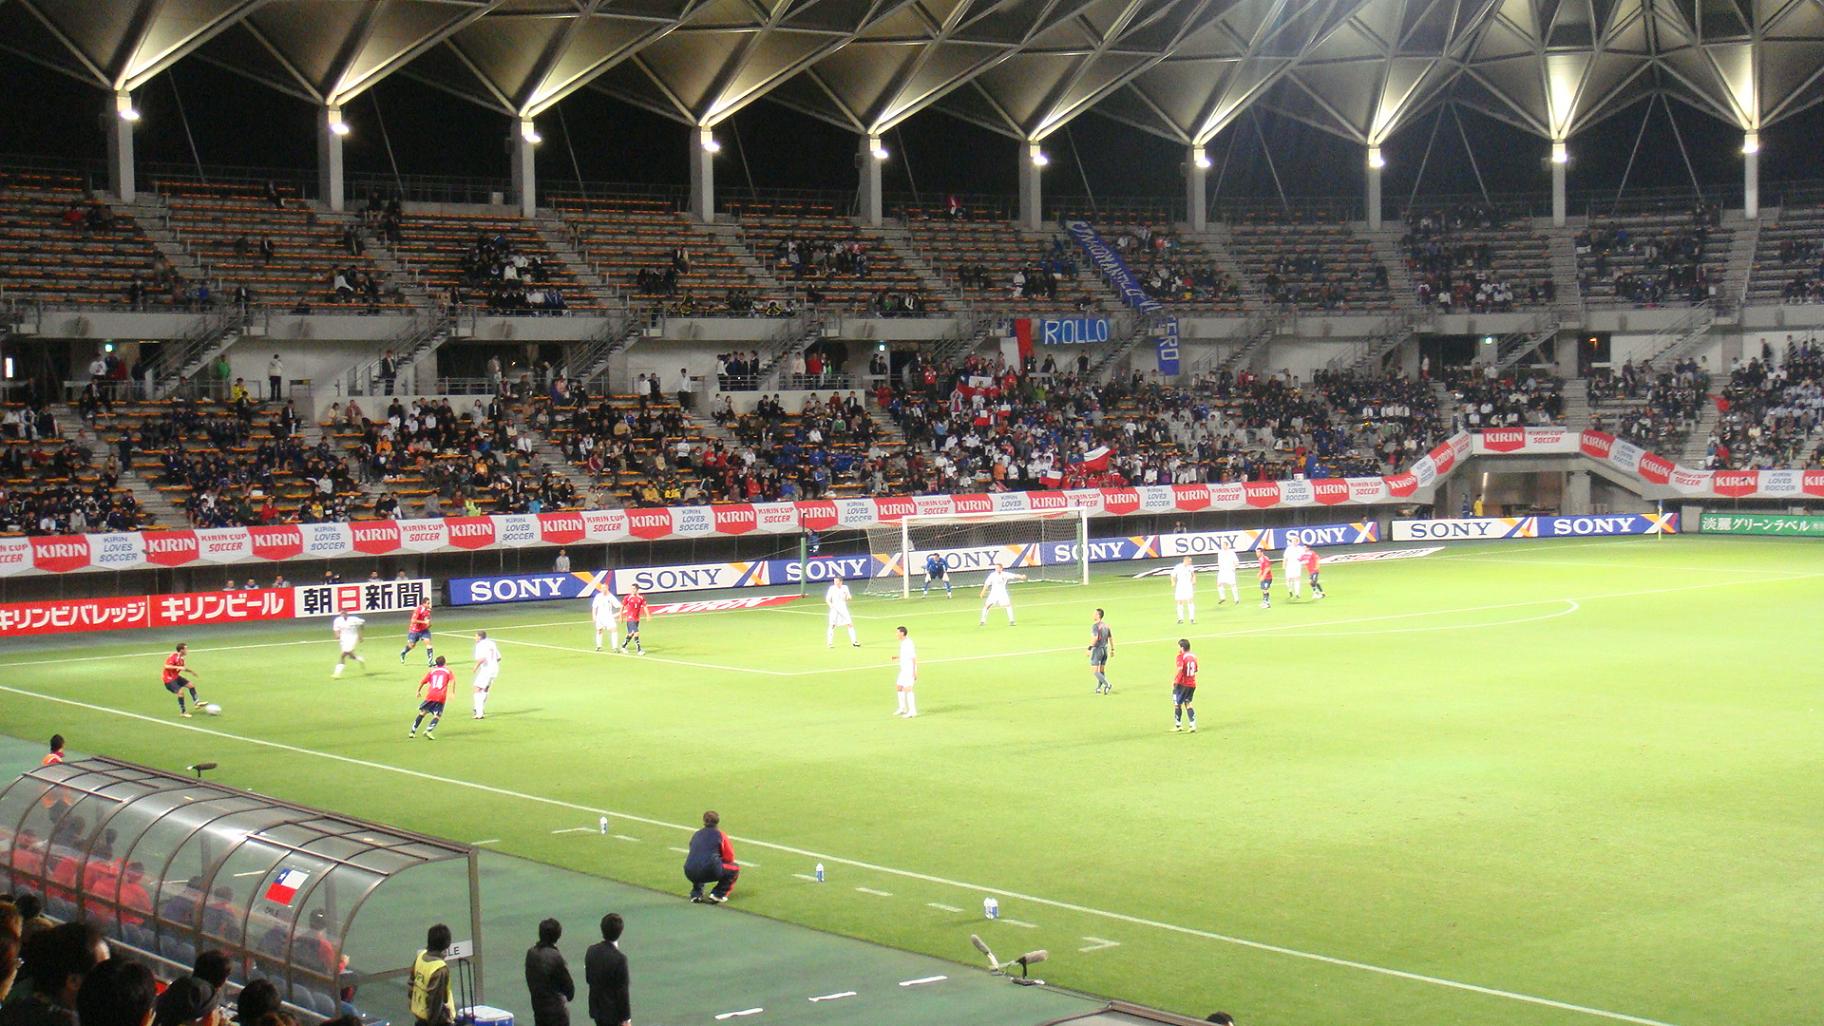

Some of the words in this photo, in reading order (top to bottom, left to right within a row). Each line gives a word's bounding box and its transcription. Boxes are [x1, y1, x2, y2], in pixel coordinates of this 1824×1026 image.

[1044, 319, 1108, 345] ROLLO
[1486, 432, 1523, 442] KIRIN
[1533, 436, 1560, 444] SOCCER
[1582, 434, 1610, 451] KIRIN
[1641, 459, 1672, 476] KIRIN
[1675, 477, 1702, 487] SOCCER
[1716, 476, 1756, 487] KIRIN
[1177, 489, 1209, 501] KIRIN
[1248, 486, 1279, 497] KIRIN
[1316, 484, 1347, 494] KIRIN
[1031, 496, 1066, 508] KIRIN
[1105, 493, 1138, 504] KIRIN
[1216, 493, 1240, 501] SOCCER
[880, 501, 915, 515] KIRIN
[923, 506, 949, 515] SOCCER
[956, 499, 991, 511] KIRIN
[717, 510, 755, 524] KIRIN
[799, 506, 836, 519] KIRIN
[543, 518, 583, 532] KIRIN
[631, 514, 670, 528] KIRIN
[682, 515, 705, 523] LOVES
[763, 515, 791, 524] SOCCER
[402, 524, 427, 532] KIRIN
[428, 523, 444, 531] CUP
[451, 523, 493, 537] KIRIN
[593, 523, 621, 533] SOCCER
[679, 523, 709, 532] SOCCER
[1410, 522, 1491, 538] SONY
[1554, 517, 1636, 535] SONY
[201, 534, 228, 542] KIRIN
[230, 533, 247, 541] CUP
[255, 532, 301, 547] KIRIN
[314, 533, 341, 541] LOVES
[355, 527, 398, 542] KIRIN
[409, 532, 440, 542] SOCCER
[502, 532, 534, 541] SOCCER
[1286, 527, 1347, 545] SONY
[104, 543, 133, 552] LOVES
[147, 537, 196, 553] KIRIN
[208, 542, 243, 553] SOCCER
[310, 542, 345, 551] SOCCER
[1175, 535, 1238, 553] SONY
[35, 543, 88, 559] KIRIN
[100, 552, 138, 562] SOCCER
[786, 558, 866, 582] SONY
[635, 568, 722, 590] SONY
[471, 577, 565, 602] SONY
[303, 582, 423, 615] 朝日新聞
[161, 592, 284, 622] キリンビール
[0, 601, 146, 630] キリンビバレッジ
[432, 675, 444, 689] 14
[448, 946, 460, 956] LE
